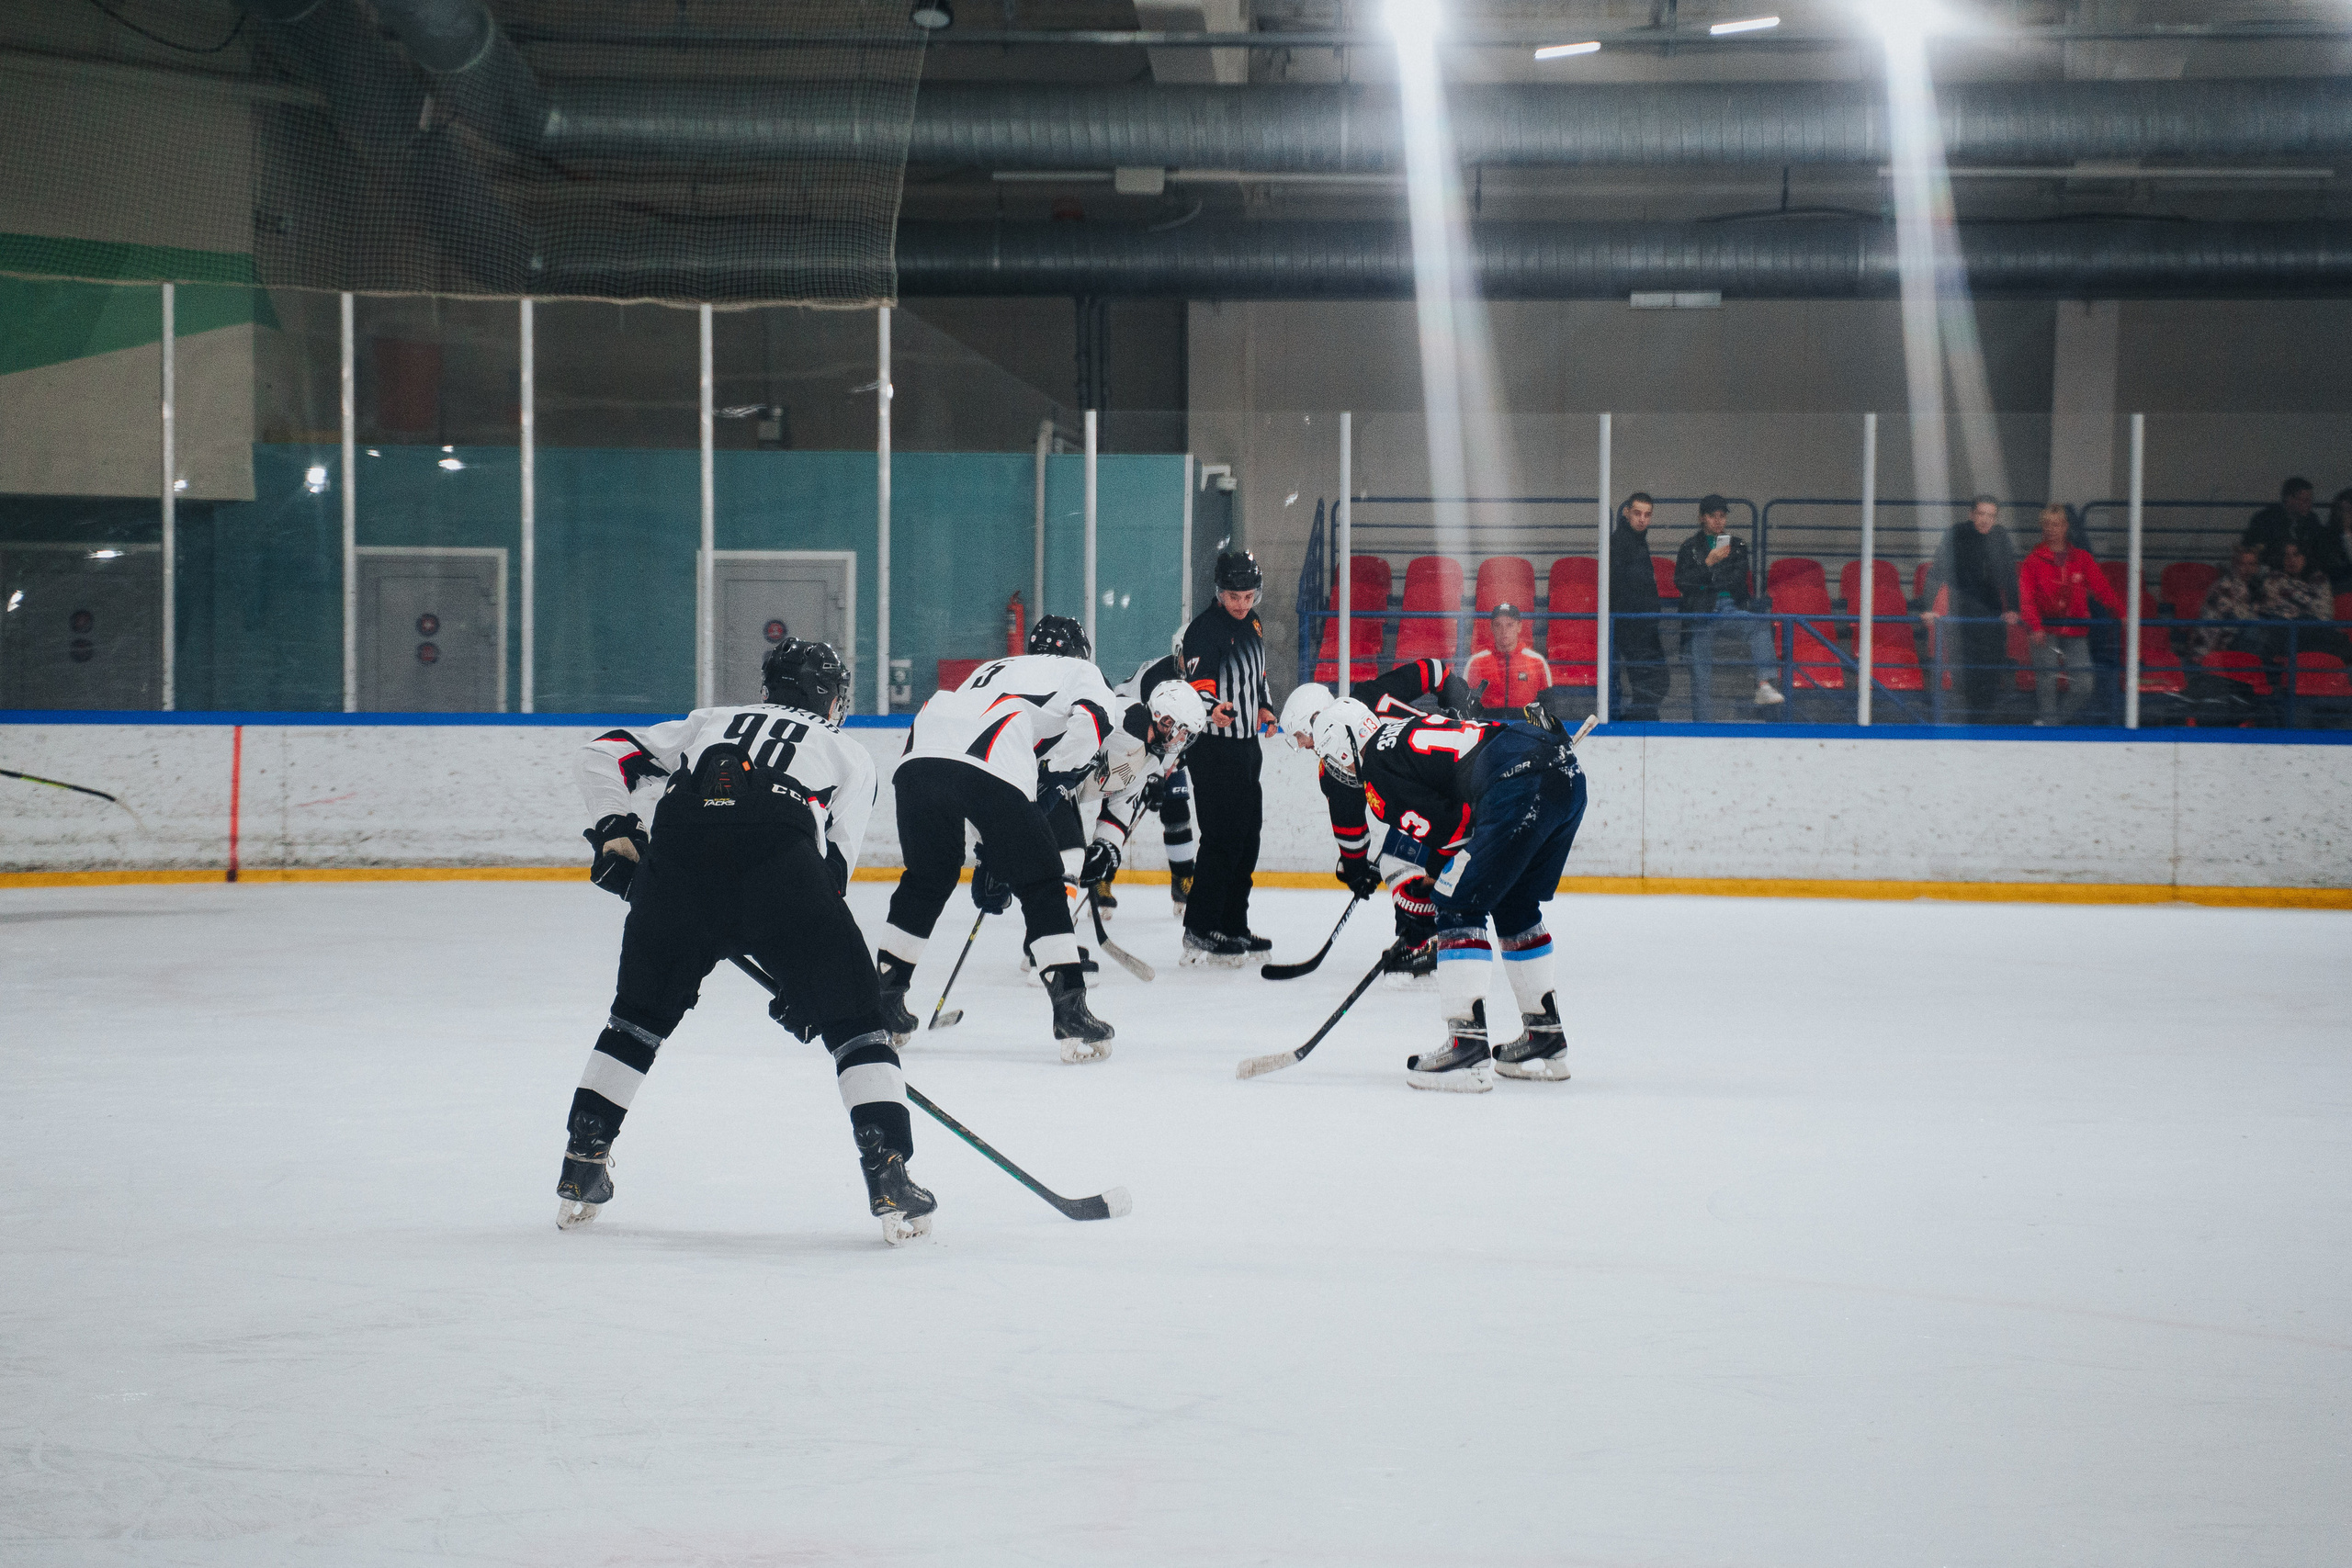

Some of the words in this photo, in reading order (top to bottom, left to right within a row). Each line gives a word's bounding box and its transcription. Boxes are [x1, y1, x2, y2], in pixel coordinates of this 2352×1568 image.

[1363, 717, 1378, 734] 13
[723, 713, 810, 773] 98
[1398, 810, 1431, 842] 3
[1396, 894, 1436, 914] ARRIO
